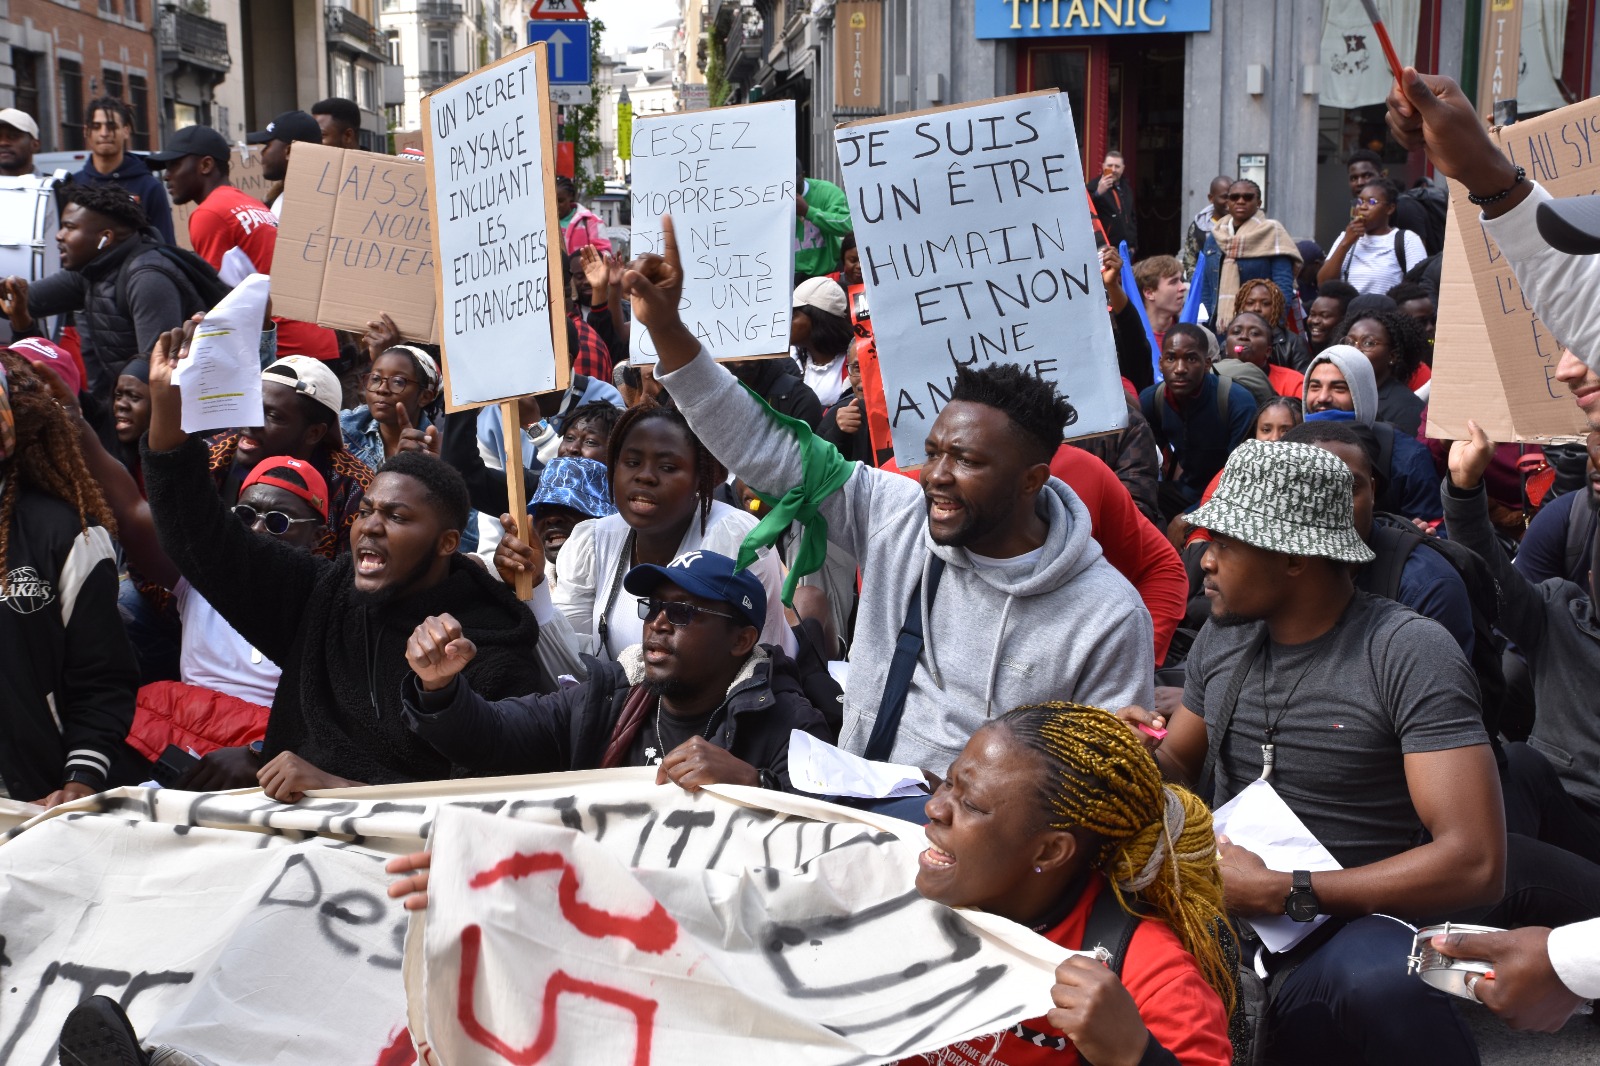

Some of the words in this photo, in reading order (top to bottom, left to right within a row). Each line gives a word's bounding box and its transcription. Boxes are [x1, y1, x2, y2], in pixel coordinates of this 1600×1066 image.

[1003, 0, 1167, 29] TITANIC
[853, 32, 862, 97] TITANIC
[1492, 18, 1506, 104] TITAN
[437, 98, 457, 139] UN
[465, 65, 529, 122] DECRET
[450, 114, 527, 181] PAYSAGE
[631, 121, 757, 158] CESSEZ
[837, 129, 889, 168] JE
[912, 110, 1039, 159] SUIS
[1528, 135, 1559, 181] AU
[450, 160, 533, 221] INCLUANT
[678, 158, 711, 183] DE
[859, 177, 921, 224] UN
[947, 153, 1070, 207] ÊTRE
[302, 225, 434, 276] ÉTUDIER
[478, 213, 507, 247] LES
[690, 220, 731, 254] NE
[865, 217, 1065, 287] HUMAIN
[693, 251, 773, 280] SUIS
[711, 277, 773, 310] UNE
[914, 280, 974, 327] ET
[985, 263, 1091, 317] NON
[638, 311, 787, 357] ANGE
[946, 321, 1036, 370] UNE
